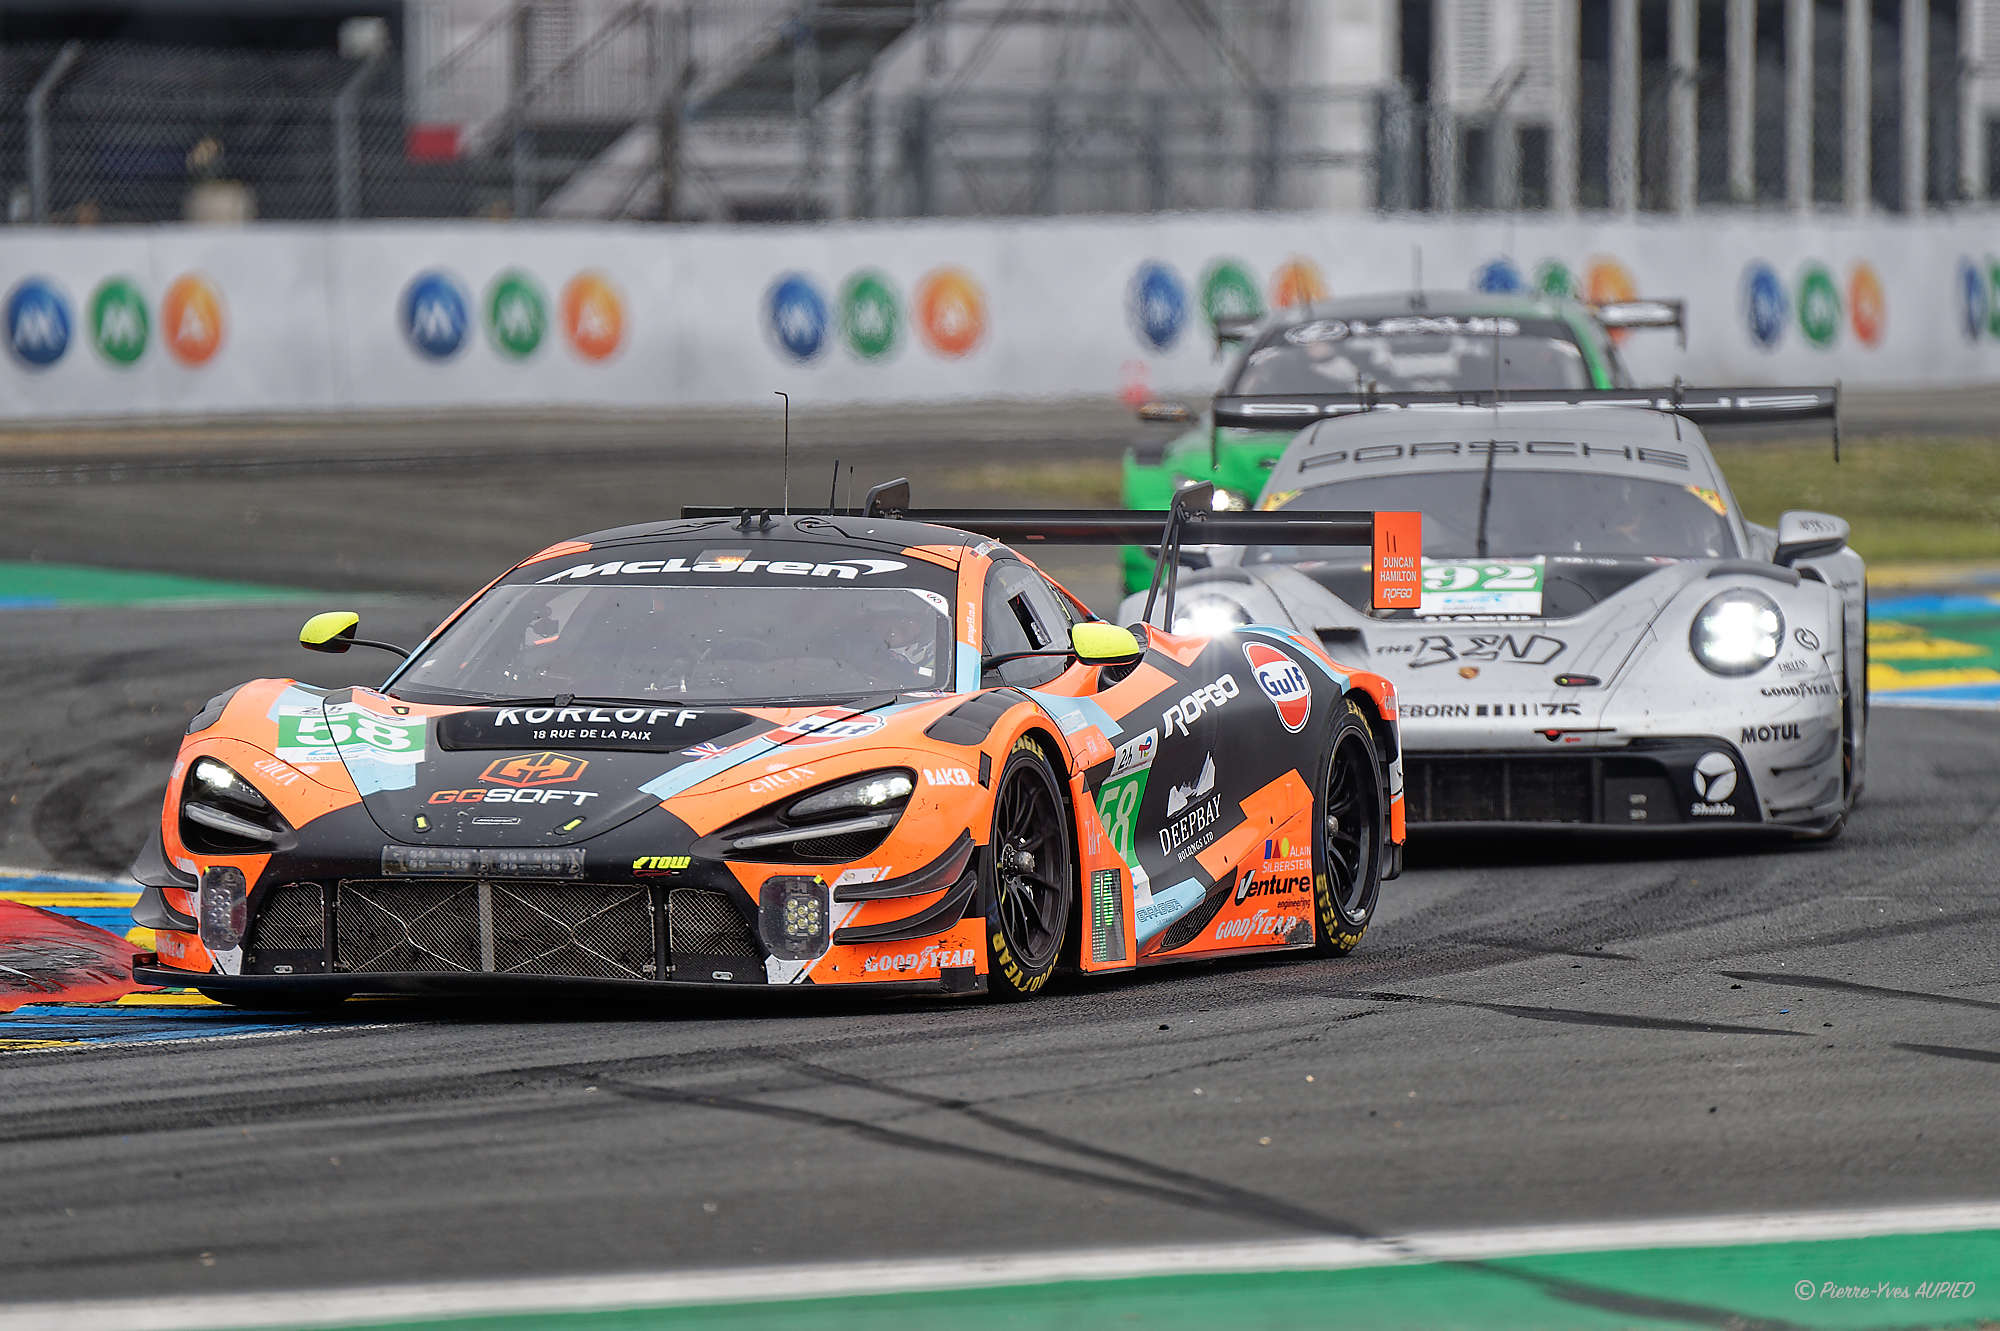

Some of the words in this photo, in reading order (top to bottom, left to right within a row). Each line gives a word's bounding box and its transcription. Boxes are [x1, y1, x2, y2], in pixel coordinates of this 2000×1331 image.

[1297, 440, 1690, 473] PORSCHE
[535, 557, 868, 585] McLaren
[1383, 556, 1414, 568] DUNCAN
[1380, 570, 1417, 582] HAMILTON
[1422, 565, 1538, 591] 92
[1258, 665, 1307, 698] Gulf
[1162, 673, 1240, 739] ROFGO
[1398, 703, 1469, 718] EBORN
[494, 708, 706, 728] KORLOFF
[295, 714, 412, 750] 58
[533, 729, 547, 740] 18
[549, 729, 577, 739] RUE
[579, 729, 598, 739] DE
[601, 729, 618, 740] LA
[621, 730, 653, 742] PAIX
[1740, 722, 1801, 745] MOTUL
[1011, 735, 1045, 762] EAGLE
[427, 788, 600, 807] GGSOFT
[1158, 793, 1223, 857] DEEPBAY
[1203, 830, 1215, 847] LTD
[1289, 843, 1312, 858] ALAIN
[650, 856, 691, 869] TOW
[1261, 858, 1312, 875] SILBERSTEIN
[1234, 868, 1311, 907] Venture
[1276, 898, 1311, 910] engineering
[1215, 908, 1297, 942] GOODYEAR
[864, 944, 975, 974] GOODYEAR
